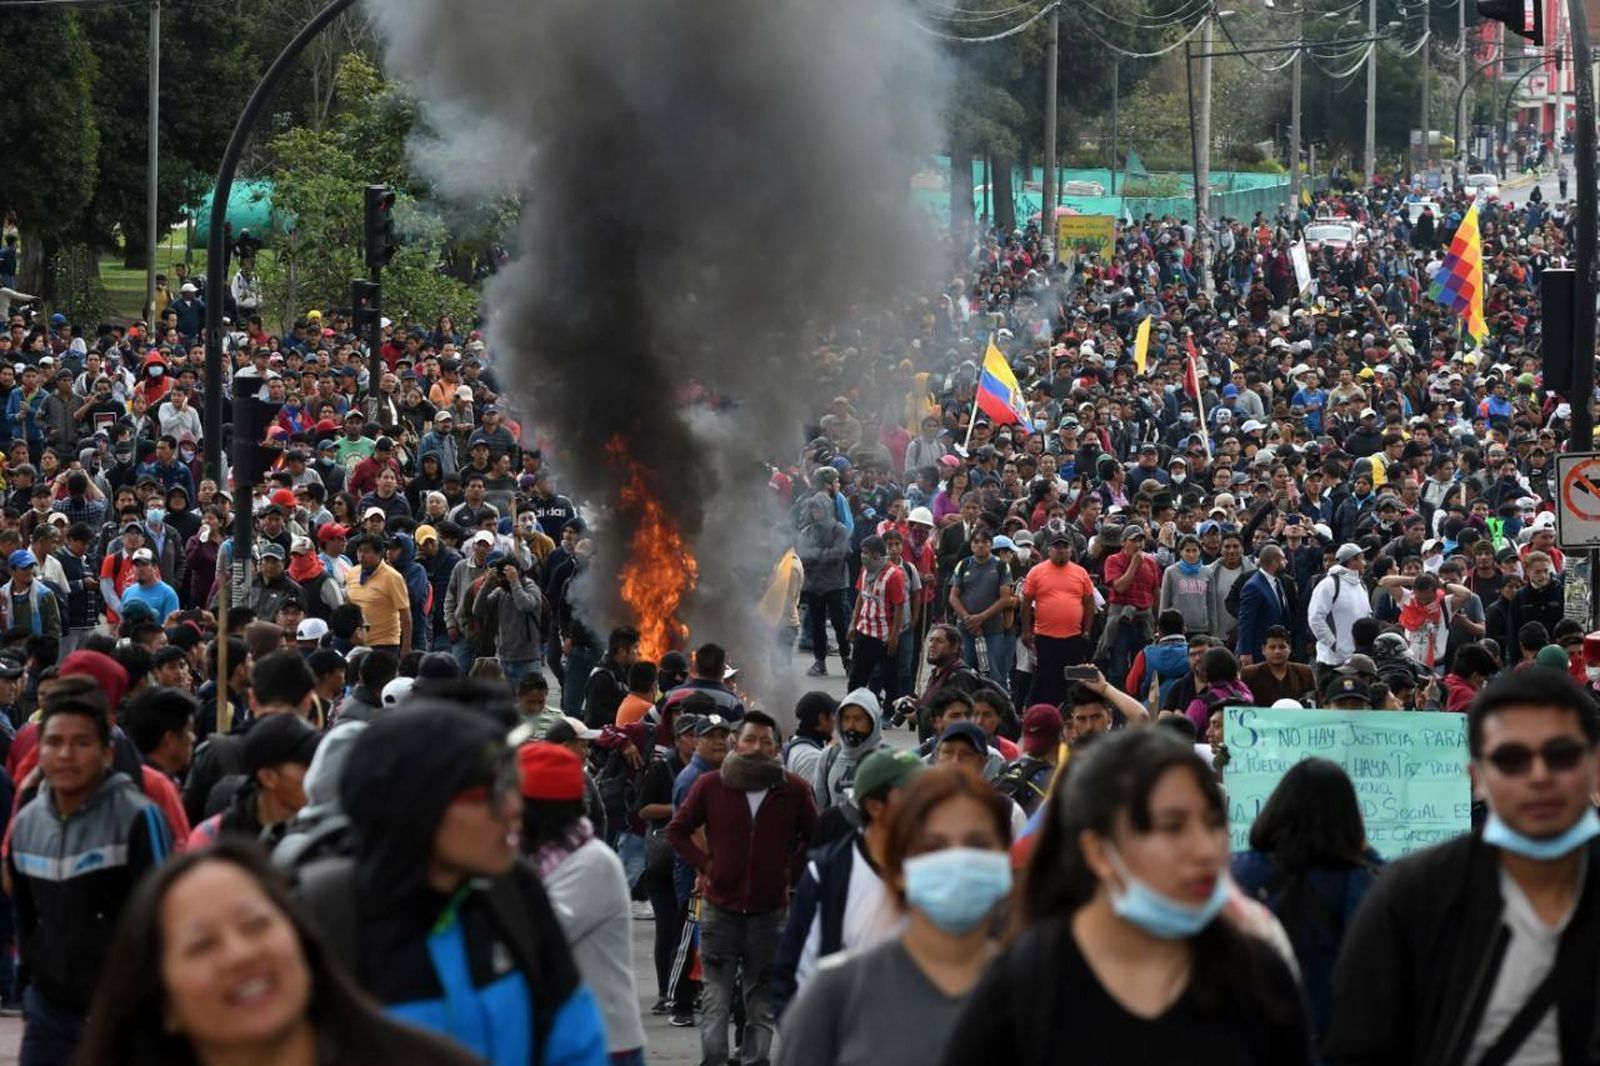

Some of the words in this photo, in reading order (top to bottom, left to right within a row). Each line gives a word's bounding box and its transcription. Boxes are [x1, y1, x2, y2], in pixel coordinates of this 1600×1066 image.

[1278, 727, 1301, 748] NO
[1308, 727, 1336, 749] HAY
[1420, 727, 1469, 748] PARA
[1354, 757, 1392, 779] HAYA
